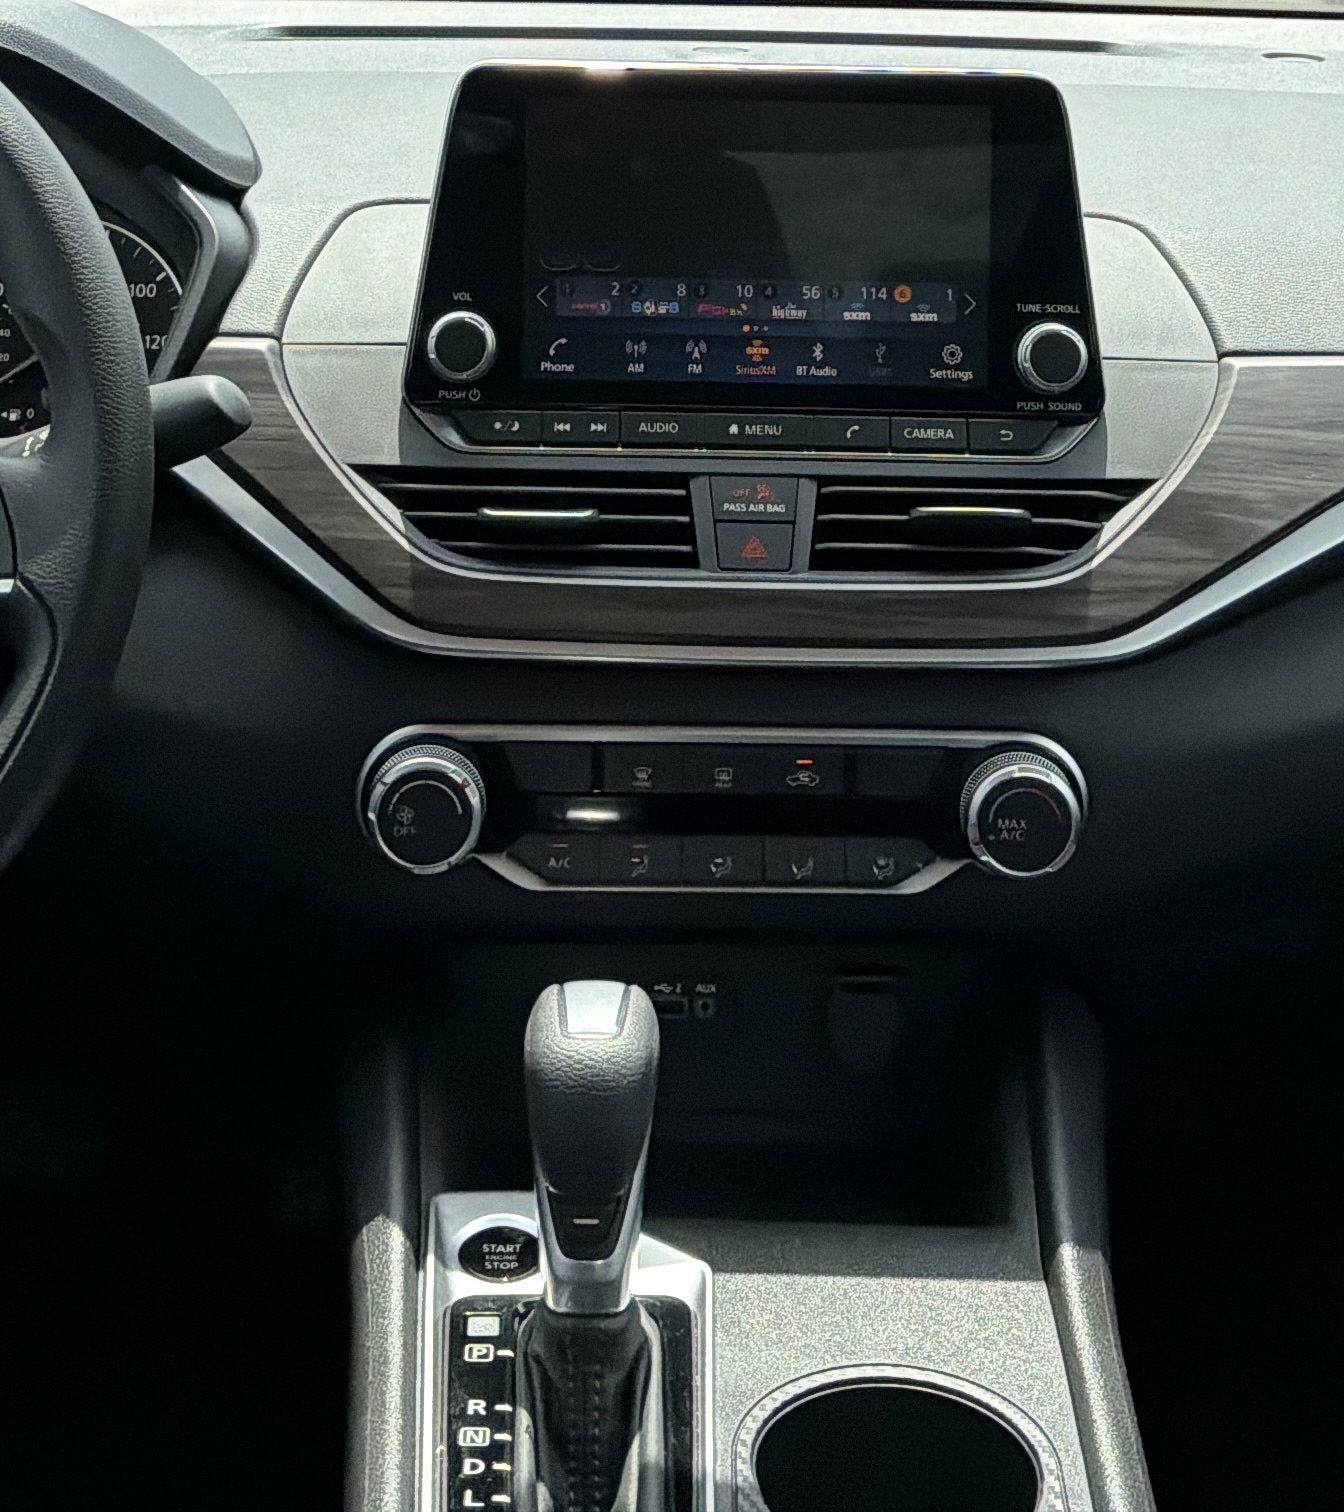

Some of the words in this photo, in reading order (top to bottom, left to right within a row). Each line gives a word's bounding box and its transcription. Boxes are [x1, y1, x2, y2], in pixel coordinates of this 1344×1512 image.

[130, 284, 156, 297] 100
[611, 282, 620, 295] 2
[677, 284, 686, 297] 8
[736, 285, 753, 298] 10
[802, 286, 820, 299] 56
[861, 287, 887, 300] 114
[947, 288, 952, 301] 1
[452, 291, 472, 301] VOL
[843, 311, 870, 320] sxm
[910, 312, 938, 321] sxm
[540, 361, 575, 372] Phone
[627, 363, 644, 373] AM
[688, 363, 702, 374] FM
[736, 364, 777, 375] SiriusXM
[796, 366, 808, 376] BT
[809, 365, 837, 377] Audio
[930, 368, 974, 381] Settings
[438, 390, 466, 399] PUSH
[1016, 401, 1044, 410] PUSH
[1048, 402, 1083, 411] SOUND
[638, 422, 679, 434] AUDIO
[744, 424, 782, 435] MENU
[904, 428, 954, 440] CAMERA
[723, 502, 746, 512] PASS
[748, 503, 764, 512] AIR
[766, 504, 786, 513] BAG
[997, 818, 1027, 829] MAX
[393, 827, 416, 837] OFF
[1000, 829, 1025, 841] A/C
[548, 857, 572, 869] A/C
[696, 983, 717, 993] AUX
[482, 1243, 522, 1252] START
[484, 1261, 519, 1270] STOP
[472, 1346, 487, 1359] P
[467, 1399, 486, 1415] R
[466, 1430, 484, 1443] N
[463, 1459, 485, 1475] D
[463, 1489, 485, 1506] L
